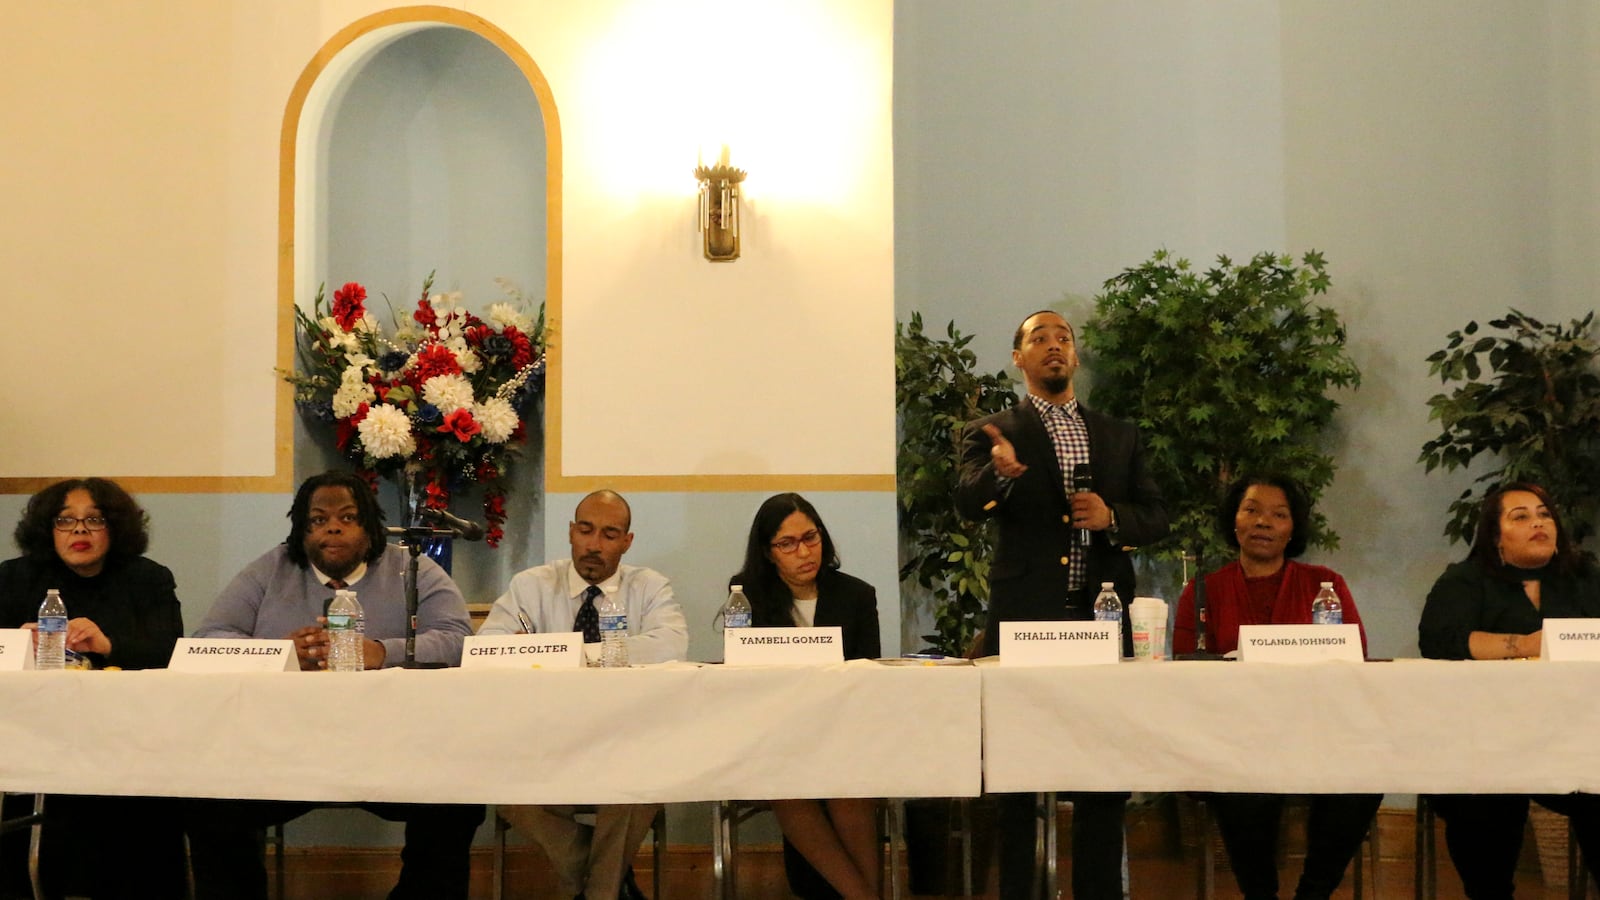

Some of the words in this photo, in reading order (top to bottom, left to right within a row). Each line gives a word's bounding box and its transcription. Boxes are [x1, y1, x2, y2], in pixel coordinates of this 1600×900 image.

[740, 636, 790, 645] YAMBELI
[792, 635, 833, 645] GOMEZ
[1014, 631, 1057, 641] KHALIL
[1059, 631, 1109, 641] HANNAH
[1250, 637, 1298, 647] YOLANDA
[1300, 637, 1346, 647] JOHNSON
[188, 645, 241, 656] MARCUS
[242, 646, 283, 657] ALLEN
[500, 645, 517, 656] J.T.
[519, 643, 568, 655] COLTER
